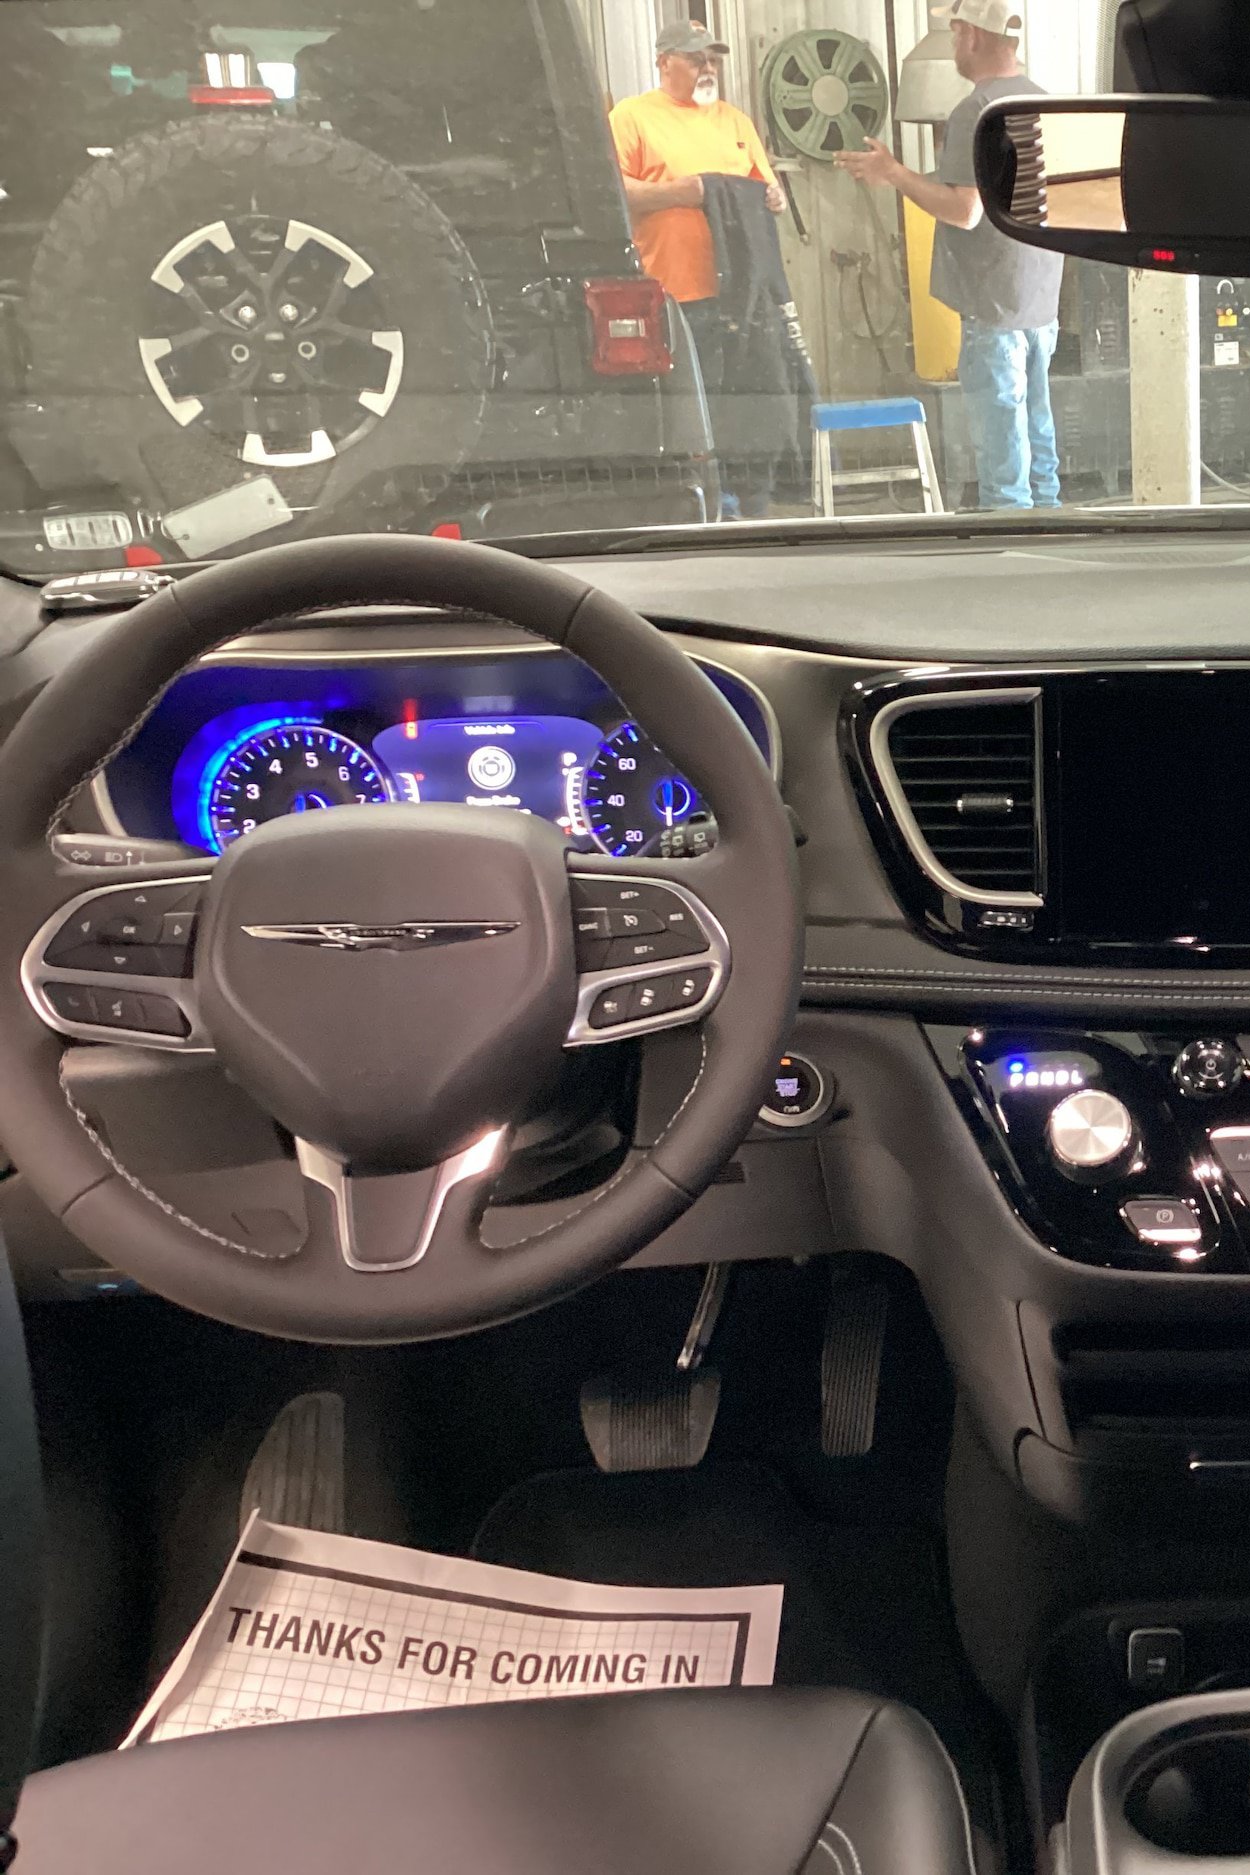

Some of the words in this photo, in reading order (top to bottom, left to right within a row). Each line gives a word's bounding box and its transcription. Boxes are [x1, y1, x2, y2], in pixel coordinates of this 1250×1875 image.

[269, 759, 283, 775] 4
[305, 751, 319, 768] 5
[618, 757, 636, 771] 60
[338, 766, 350, 781] 6
[246, 783, 260, 800] 3
[607, 794, 625, 807] 40
[242, 819, 256, 834] 2
[625, 830, 643, 843] 20
[226, 1606, 386, 1665] THANKS
[397, 1635, 478, 1681] FOR
[490, 1650, 648, 1686] COMING
[660, 1654, 700, 1684] IN
